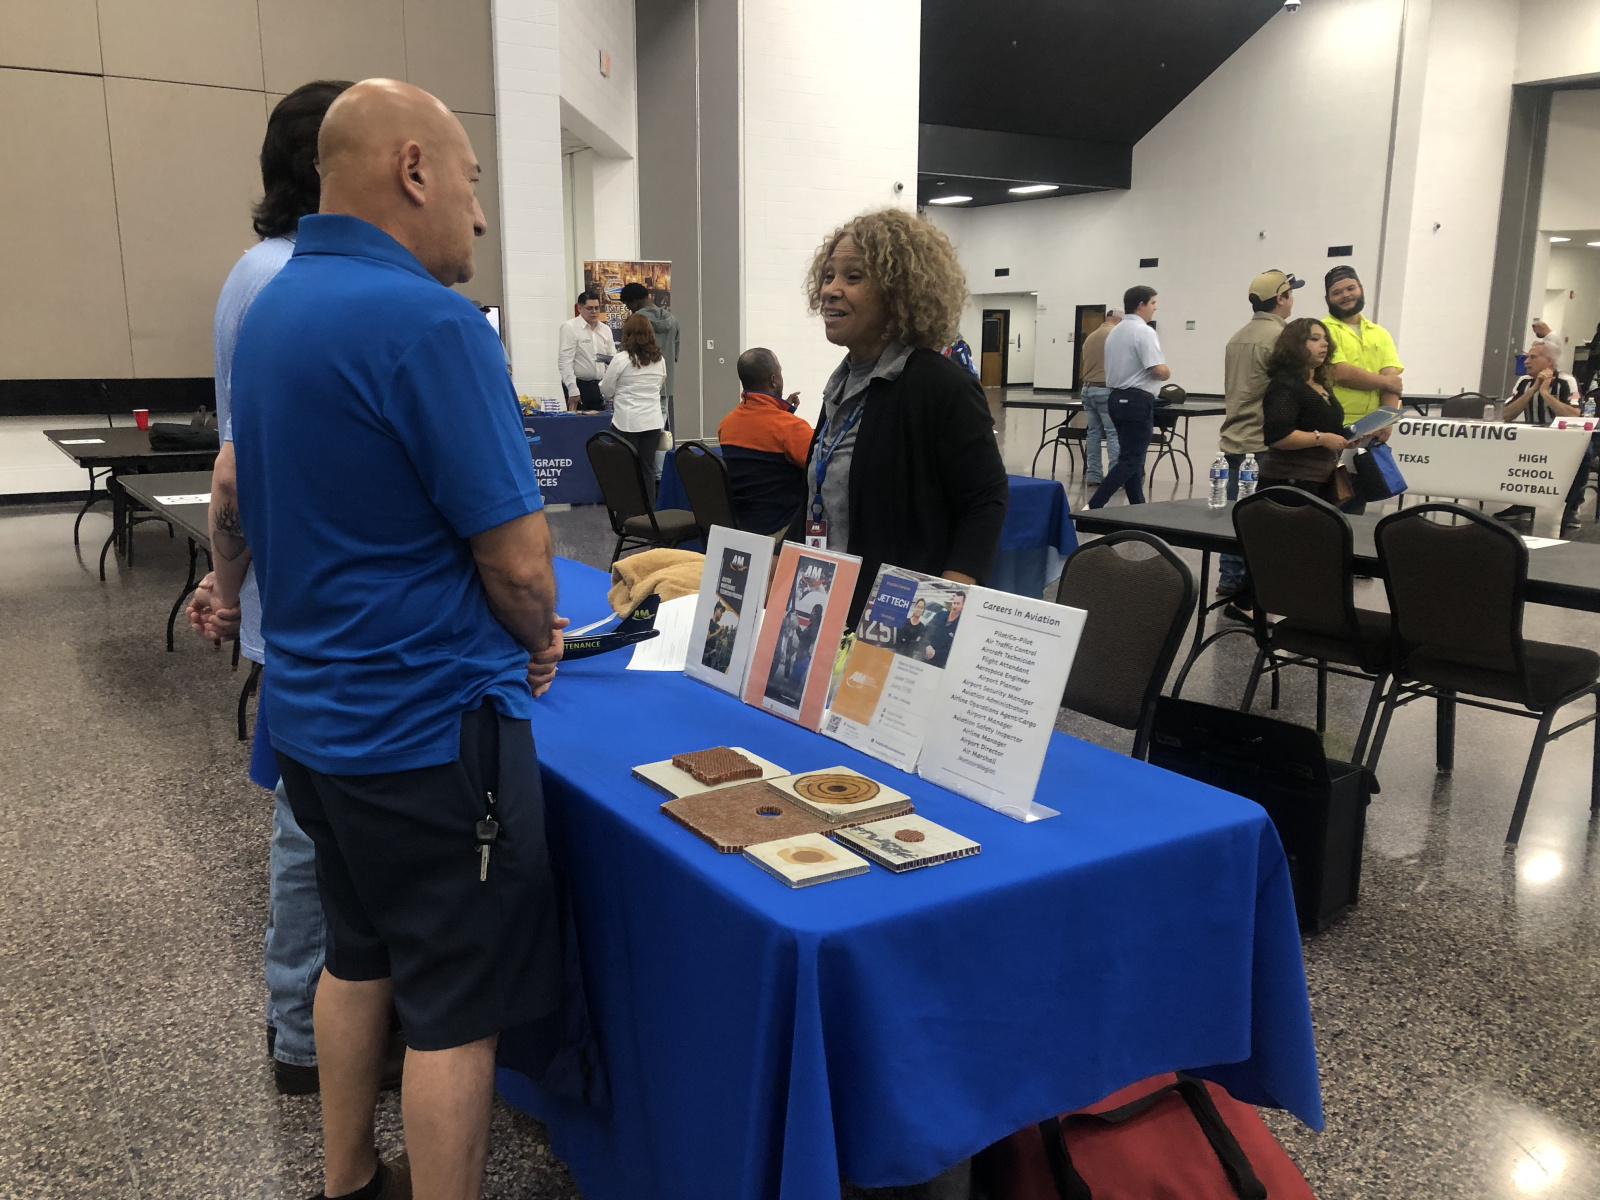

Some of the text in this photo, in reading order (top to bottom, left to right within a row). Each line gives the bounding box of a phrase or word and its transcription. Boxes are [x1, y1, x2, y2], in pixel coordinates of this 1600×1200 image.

[1398, 422, 1517, 441] OFFICIATING
[1398, 454, 1430, 464] TEXAS
[1519, 454, 1548, 464] HIGH
[536, 478, 558, 486] ICES
[1508, 468, 1554, 480] SCHOOL
[1500, 483, 1559, 495] FOOTBALL
[732, 555, 745, 566] AM
[805, 565, 822, 578] AM
[878, 594, 910, 609] JET TECH
[983, 602, 1060, 626] Careers In Aviation
[994, 631, 1033, 645] Pilot/Co-Pilot
[981, 646, 1035, 666] Aircraft Technician
[996, 640, 1013, 650] Traffic
[1015, 646, 1037, 656] Control
[982, 656, 1029, 674] Flight Attendant
[976, 664, 1030, 684] Aerospace Engineer
[978, 675, 1022, 692] Airport Planner
[963, 679, 1034, 706] Airport Security Manager
[962, 689, 1028, 715] Aviation Administrators
[951, 694, 1036, 728] Airline Operations Agent/Cargo
[966, 710, 1012, 729] Airport Manager
[953, 715, 1022, 743] Aviation Safety Inspector
[963, 728, 1006, 748] Airline Manager
[961, 737, 1004, 757] Airport Director
[972, 750, 996, 764] Marshall
